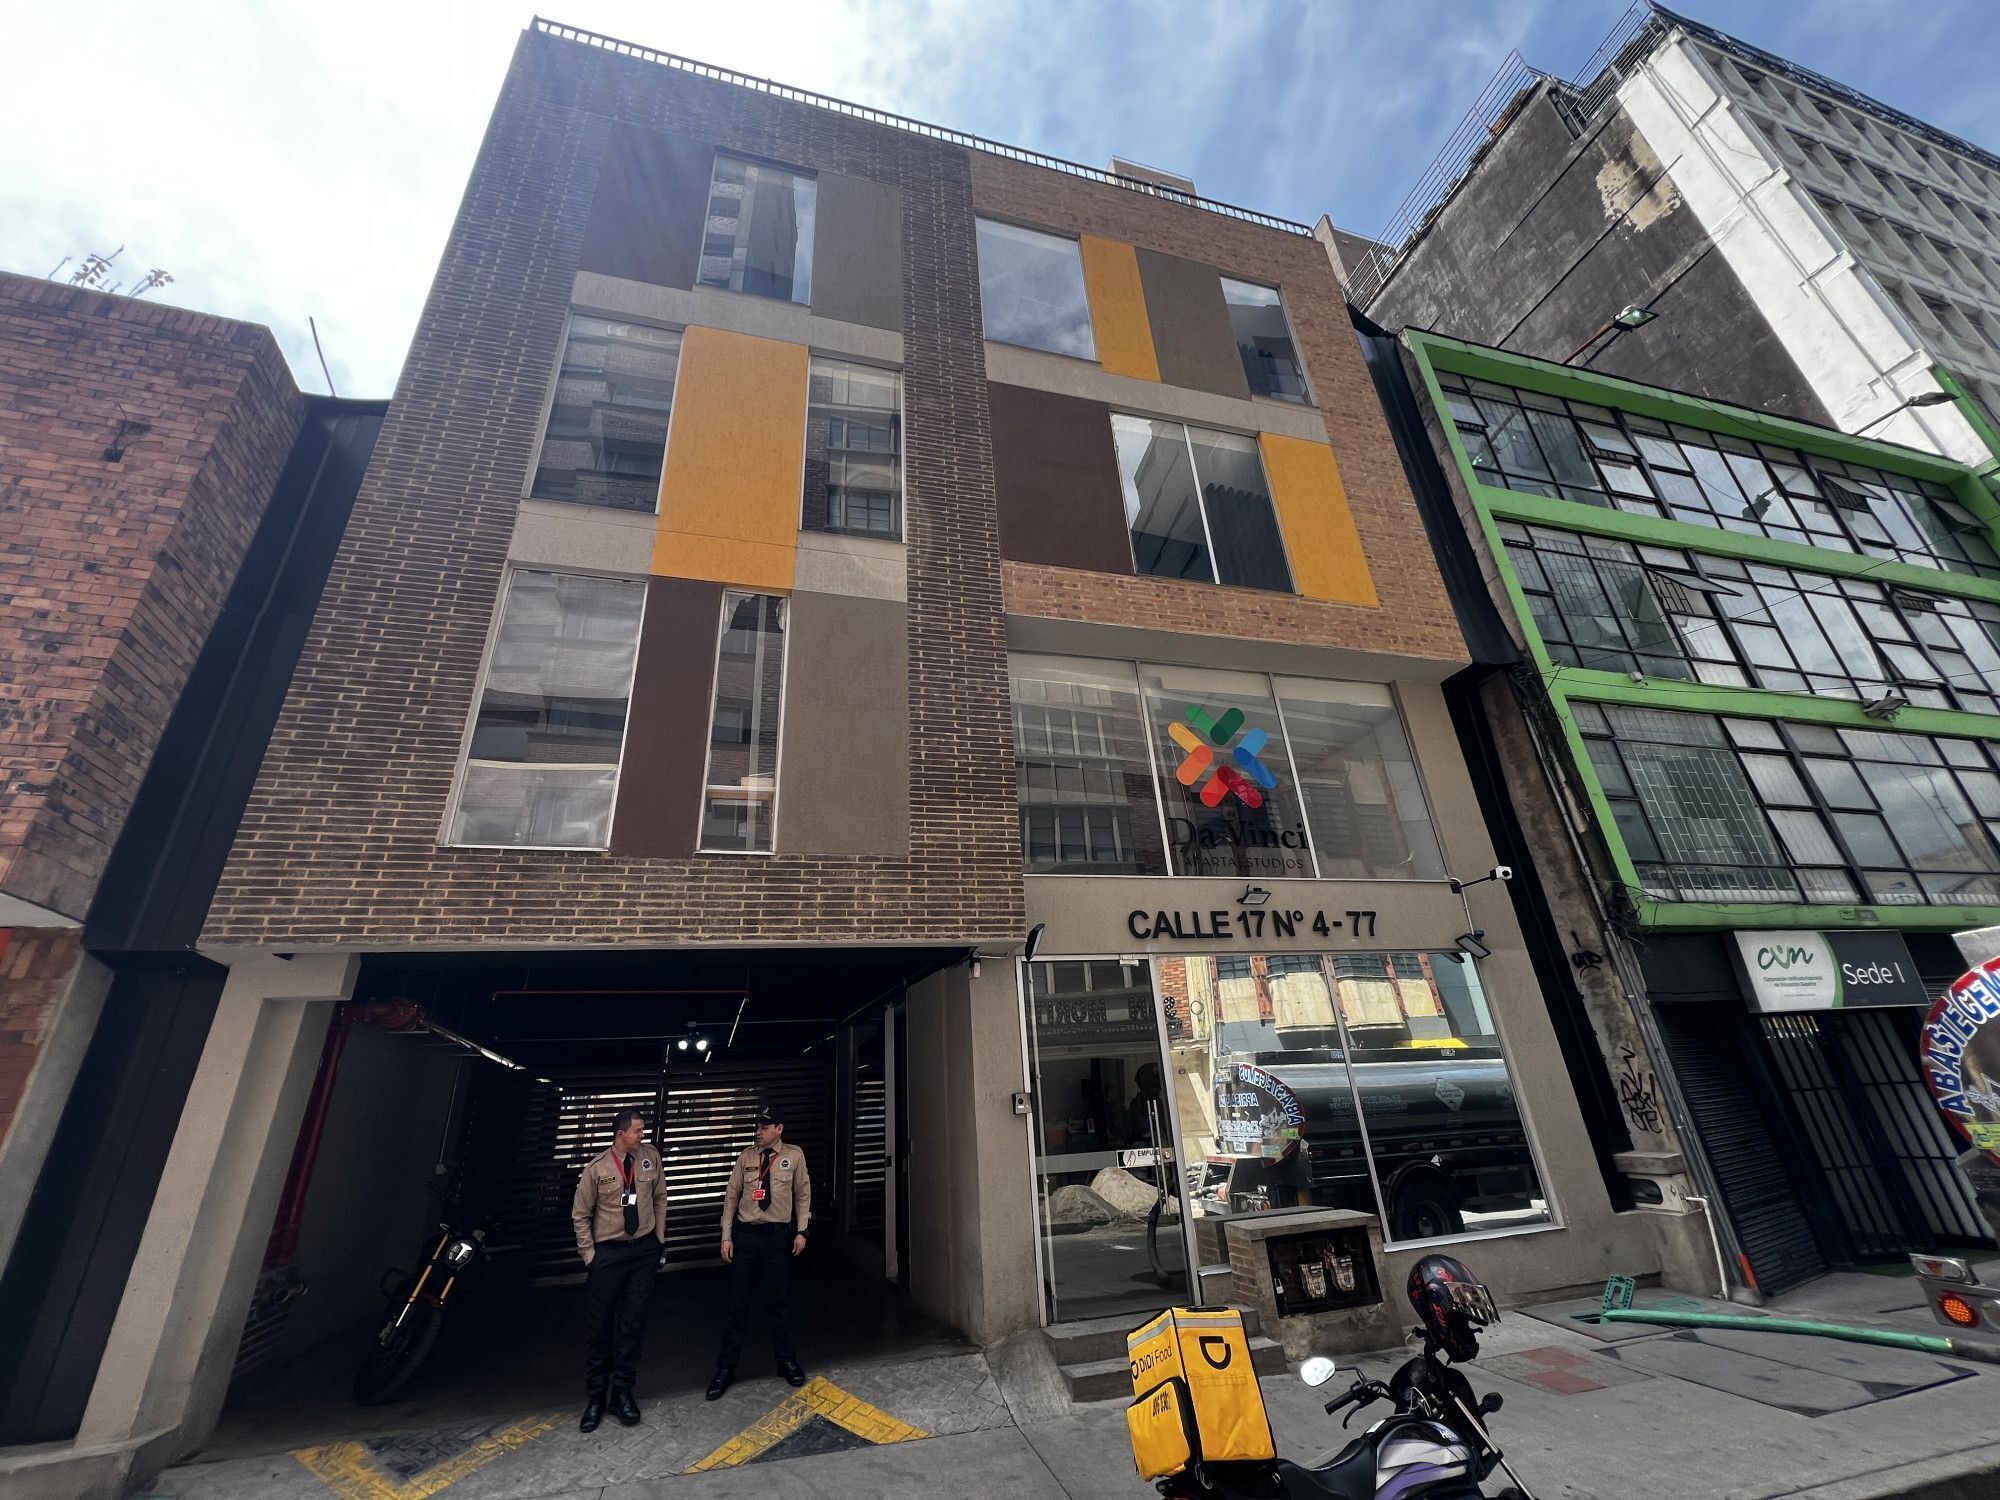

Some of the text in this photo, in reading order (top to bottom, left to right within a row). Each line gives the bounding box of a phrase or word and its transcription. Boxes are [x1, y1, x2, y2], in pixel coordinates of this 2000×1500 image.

[1167, 817, 1309, 853] Da Vinci
[1128, 909, 1234, 939] CALLE
[1236, 910, 1266, 937] 17
[1842, 962, 1894, 985] Sede
[1138, 1340, 1172, 1373] DiDi Food
